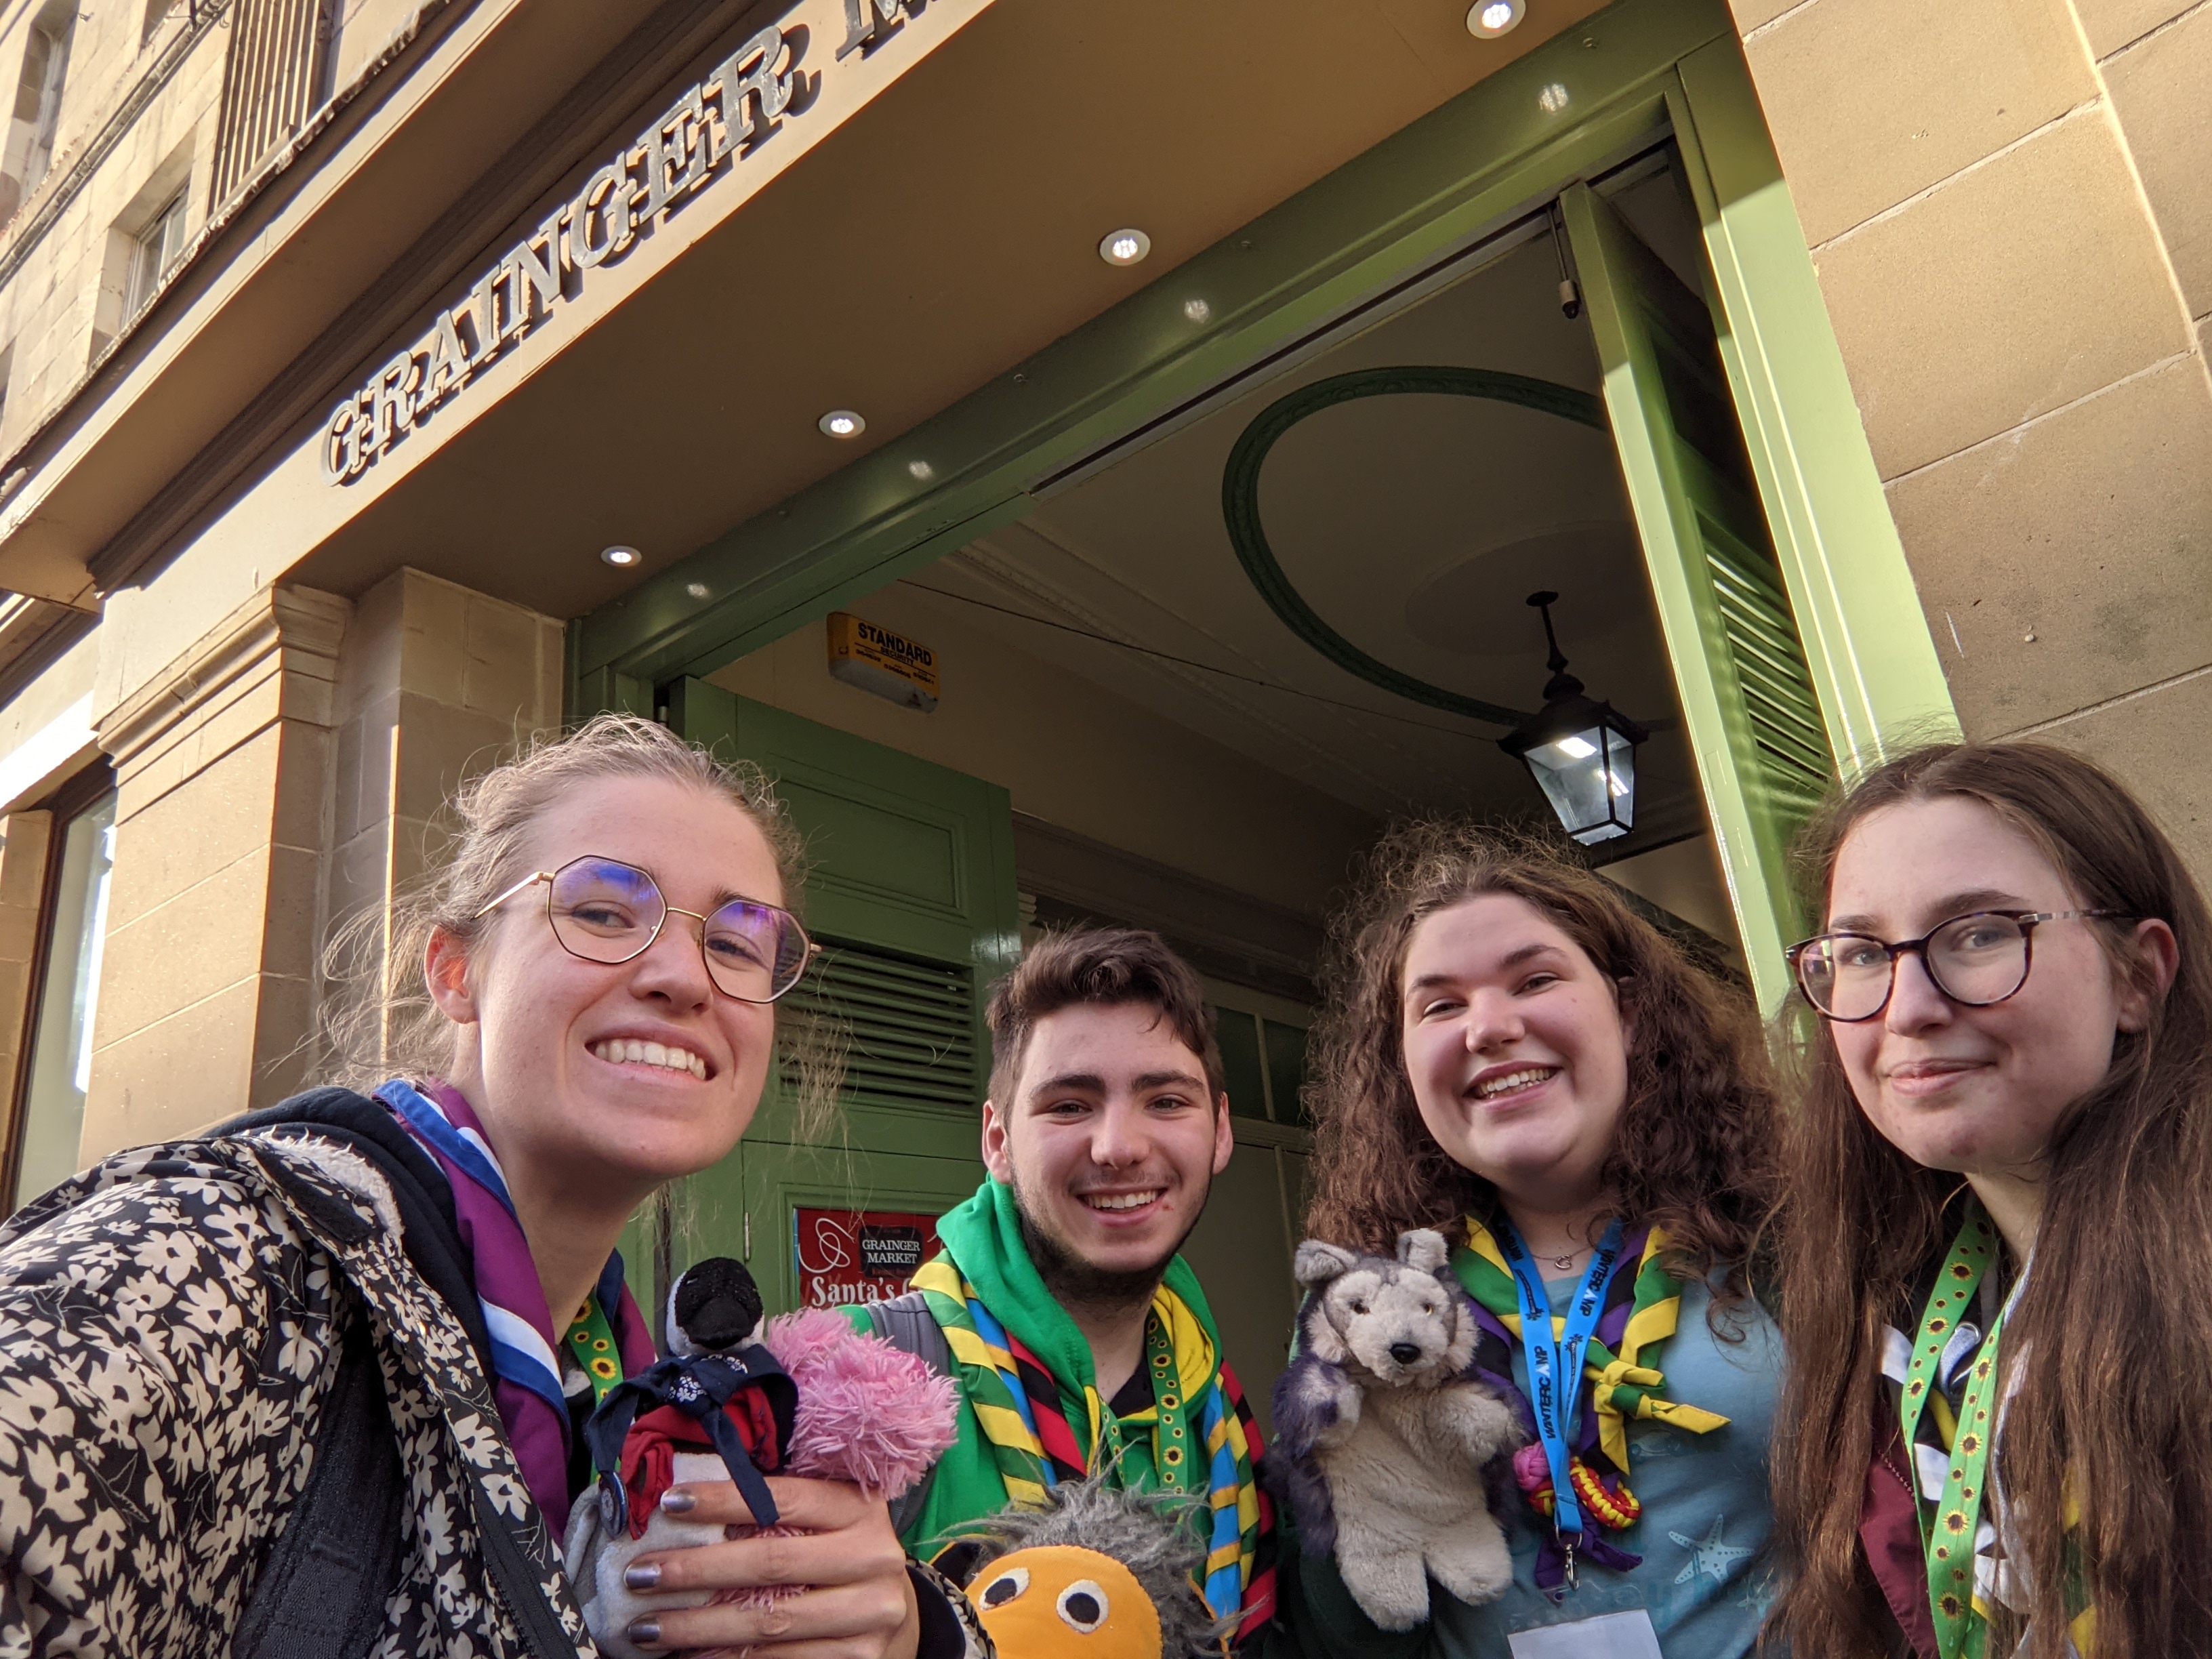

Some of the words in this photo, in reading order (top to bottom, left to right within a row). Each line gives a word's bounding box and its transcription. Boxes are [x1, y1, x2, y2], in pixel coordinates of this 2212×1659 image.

[321, 24, 794, 487] GRAINGER
[858, 622, 932, 666] STANDARD
[880, 647, 914, 665] SECURITY
[862, 1239, 921, 1252] GRAINGER
[866, 1252, 918, 1264] MARKET
[812, 1275, 895, 1307] Santa's
